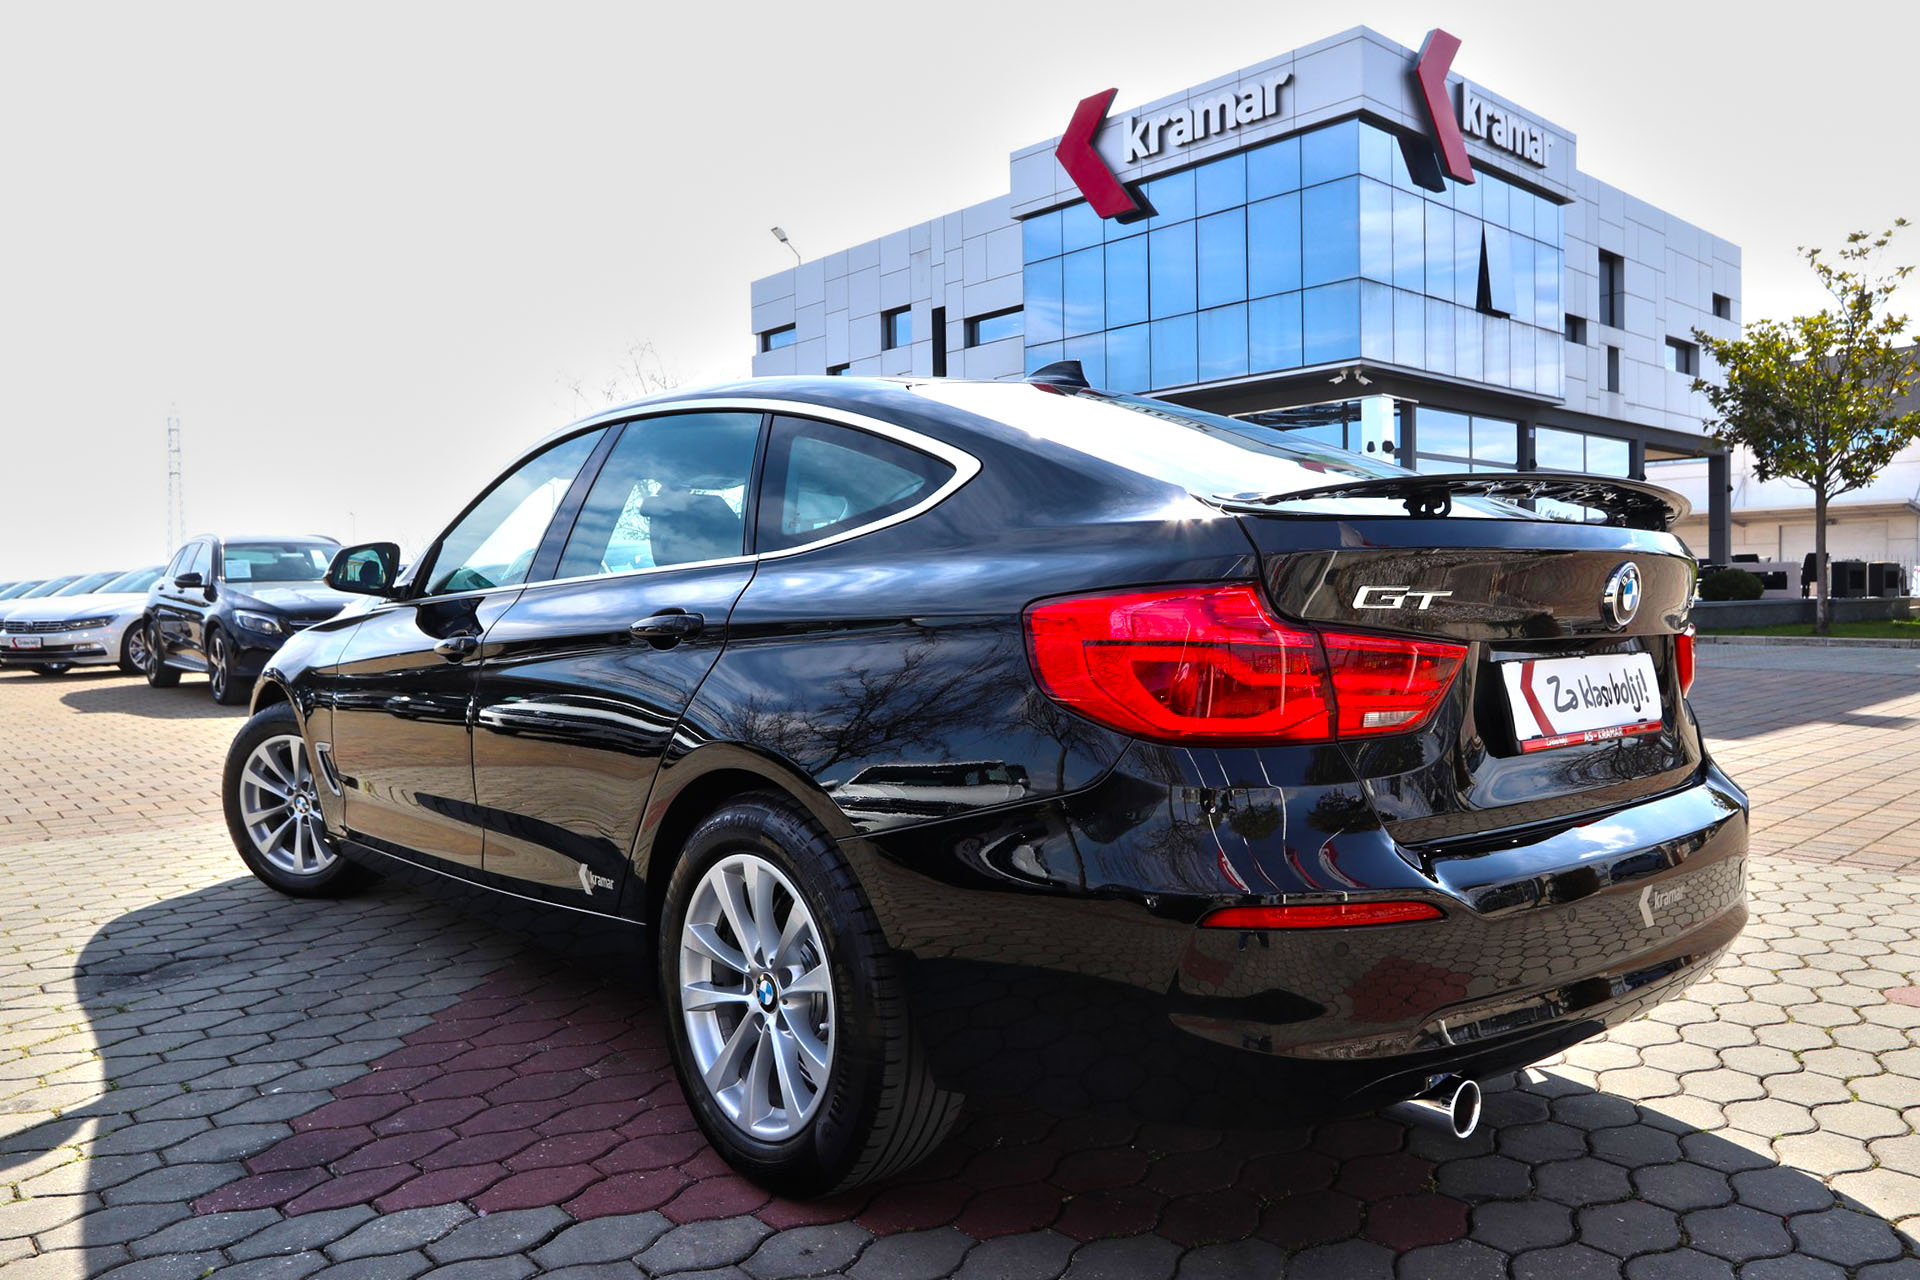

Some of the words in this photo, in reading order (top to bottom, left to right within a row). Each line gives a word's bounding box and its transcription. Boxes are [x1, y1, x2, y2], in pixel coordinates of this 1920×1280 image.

[1123, 71, 1294, 163] kramar
[1462, 81, 1554, 168] kramar
[1352, 585, 1453, 610] GT
[1546, 675, 1579, 713] Za
[589, 870, 615, 891] kramar
[1654, 885, 1687, 910] kramar
